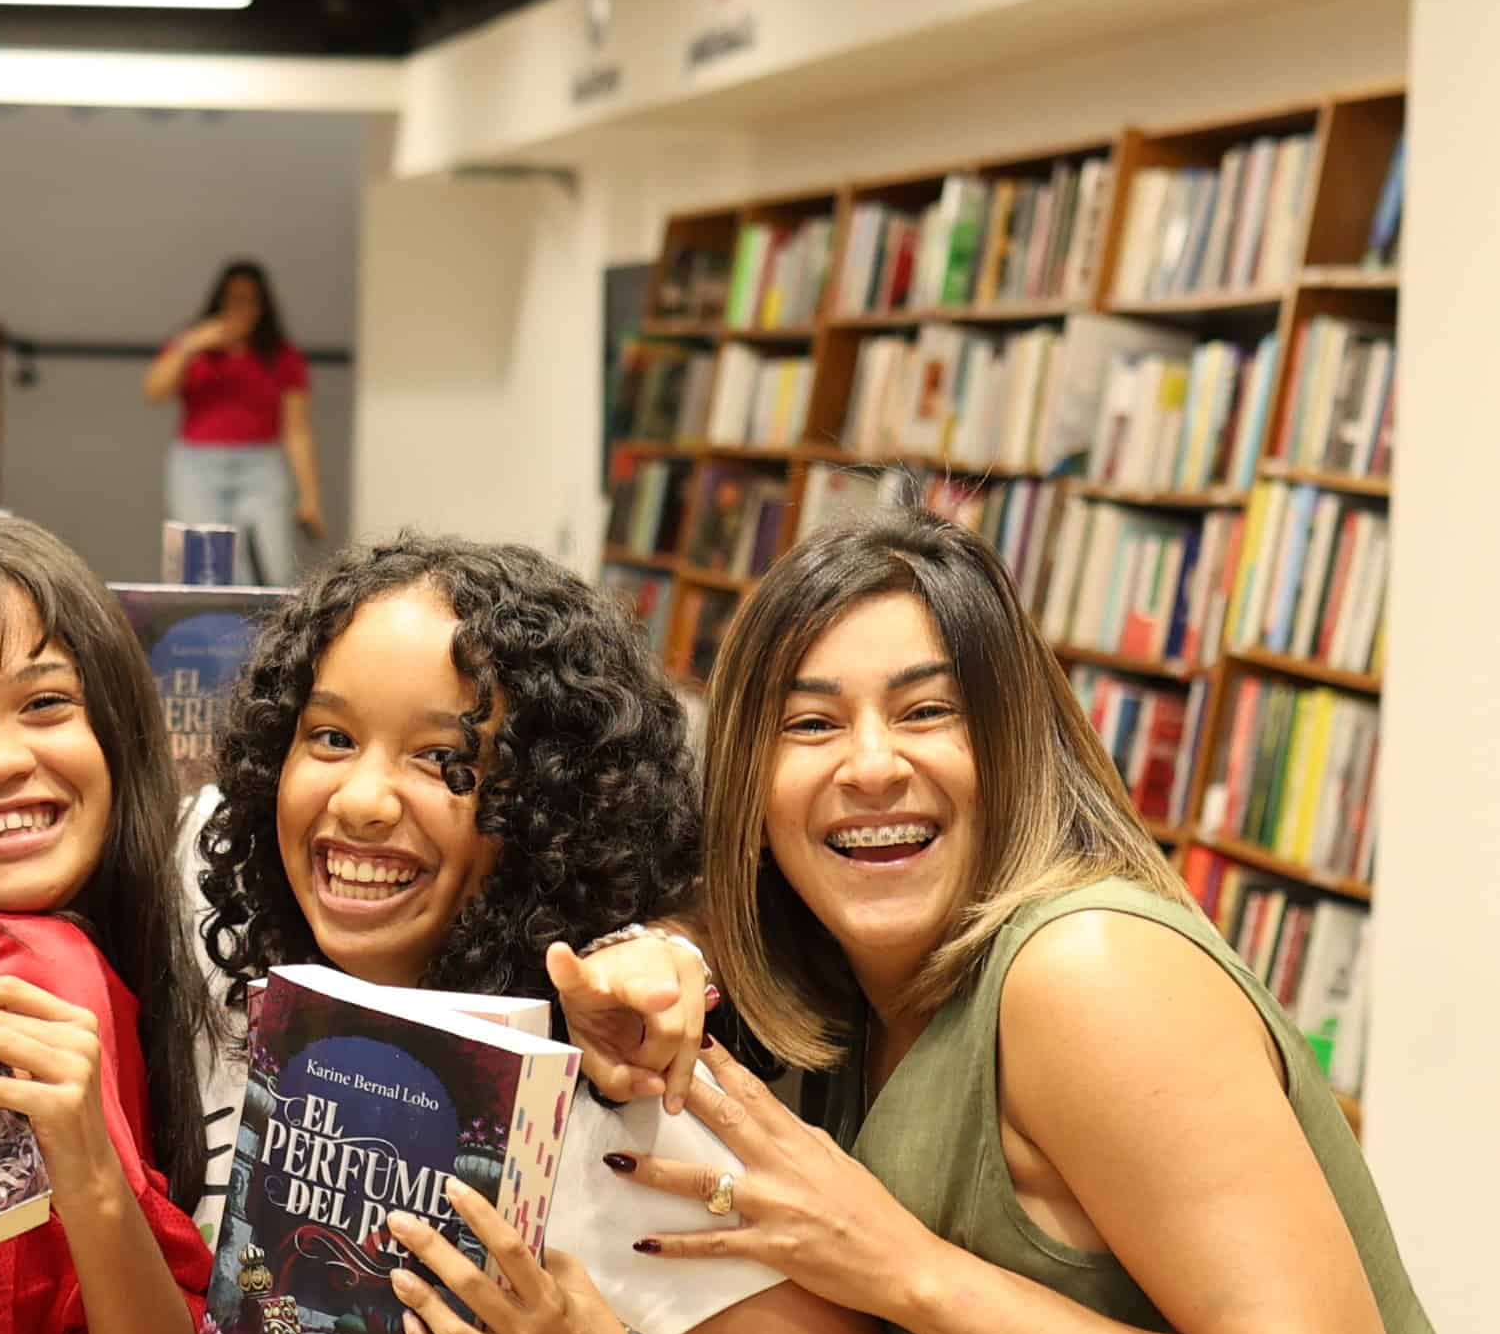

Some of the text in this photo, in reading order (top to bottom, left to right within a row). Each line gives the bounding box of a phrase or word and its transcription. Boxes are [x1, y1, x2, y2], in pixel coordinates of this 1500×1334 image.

[307, 1058, 440, 1111] Karine Bernal Lobo
[301, 1093, 344, 1138] EL
[261, 1118, 457, 1220] PERFUME
[285, 1178, 351, 1230] DEL
